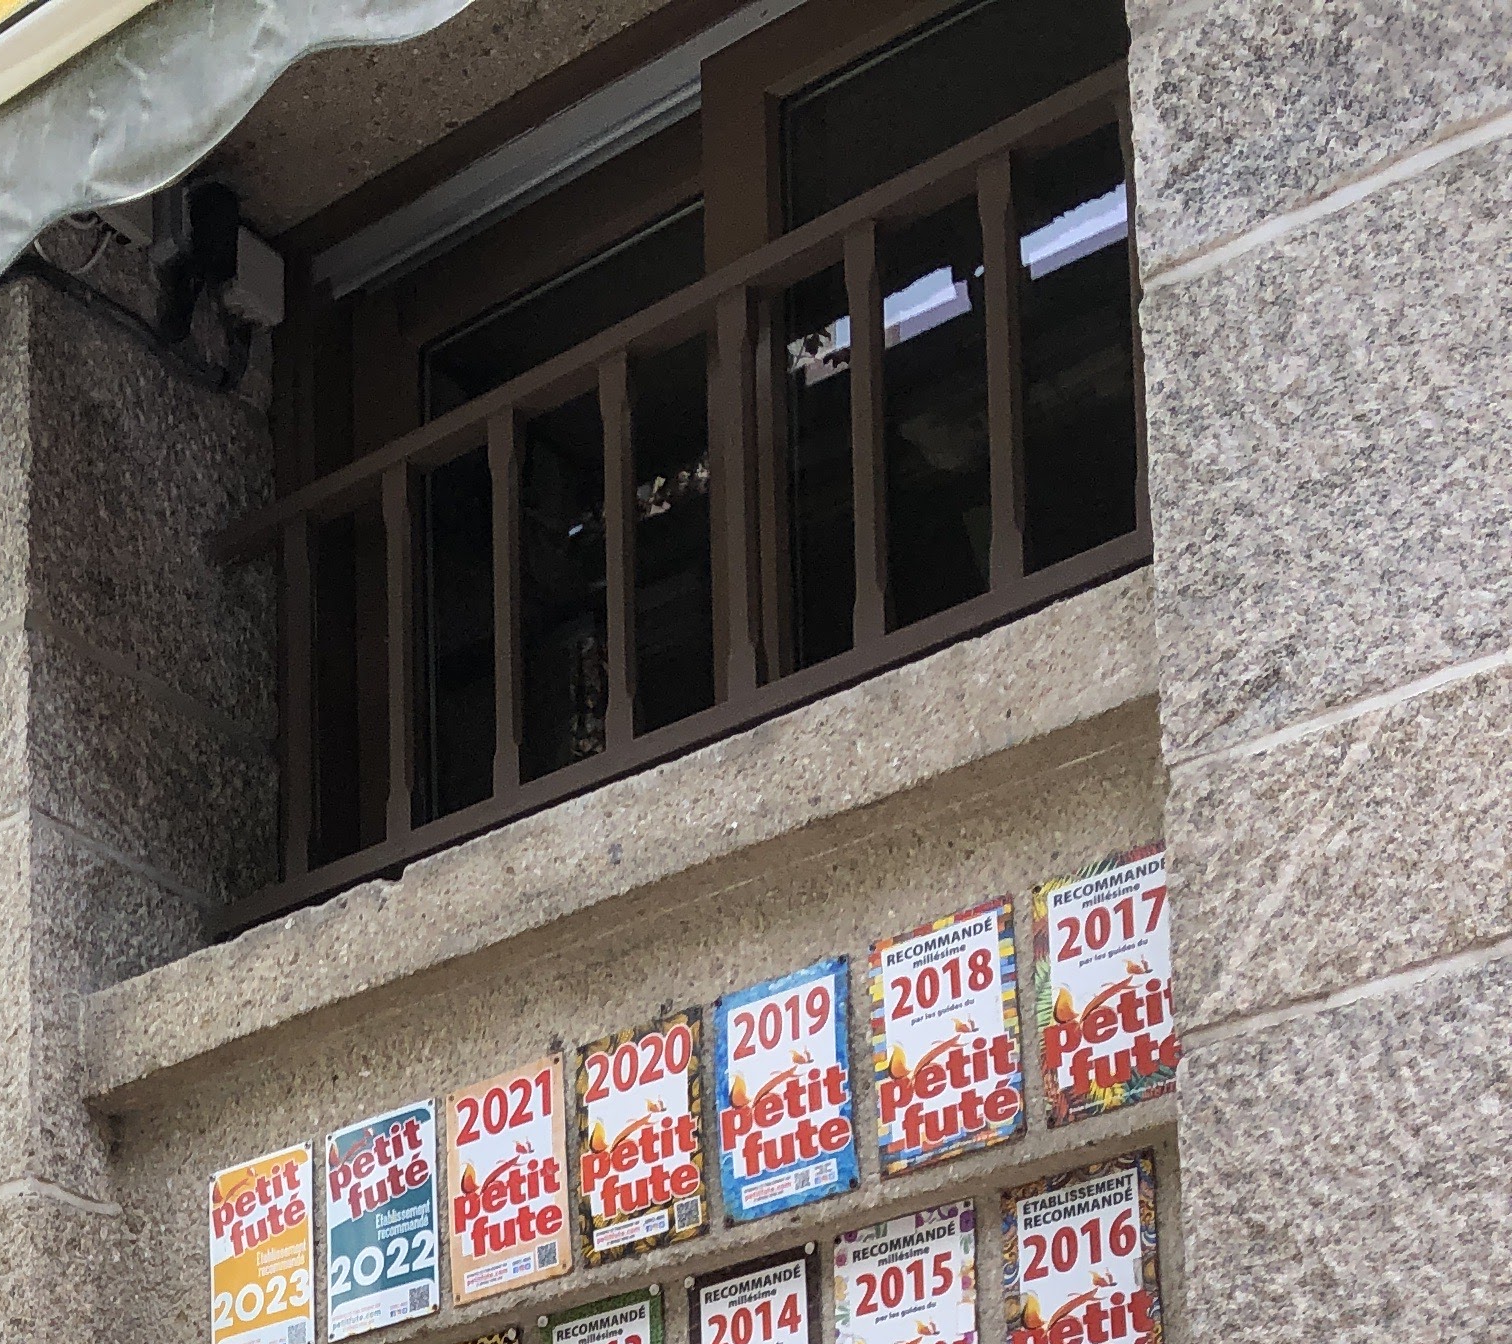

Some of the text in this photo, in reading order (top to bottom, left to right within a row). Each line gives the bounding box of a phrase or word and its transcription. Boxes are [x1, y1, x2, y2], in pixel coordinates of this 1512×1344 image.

[1057, 885, 1168, 963] 2017
[1082, 883, 1141, 910] millésime
[886, 917, 994, 967] RECOMMANDÉ
[913, 943, 966, 969] millésime
[890, 948, 994, 1021] 2018
[733, 986, 831, 1061] 2019
[585, 1024, 692, 1105] 2020
[880, 1034, 1016, 1124] petit
[456, 1069, 552, 1147] 2021
[720, 1065, 848, 1152] petit
[902, 1080, 1019, 1149] futé
[328, 1117, 423, 1203] petit
[348, 1152, 430, 1221] futé
[581, 1114, 699, 1196] petit
[212, 1160, 302, 1239] petit
[230, 1192, 306, 1257] futé
[376, 1199, 430, 1229] Etablissement
[454, 1157, 561, 1235] petit
[1023, 1173, 1134, 1215] ÉTABLISSEMENT
[1024, 1187, 1133, 1230] RECOMMANDÉ
[377, 1215, 429, 1241] recommandé
[852, 1221, 956, 1263] RECOMMANDÉ
[878, 1245, 929, 1267] millésime
[1023, 1208, 1137, 1282] 2016
[331, 1230, 435, 1297] 2022
[704, 1265, 801, 1304] RECOMMANDÉ
[856, 1252, 954, 1317] 2015
[214, 1269, 310, 1331] 2023
[556, 1305, 646, 1342] RECOMMANDÉ
[728, 1288, 777, 1308] millésime
